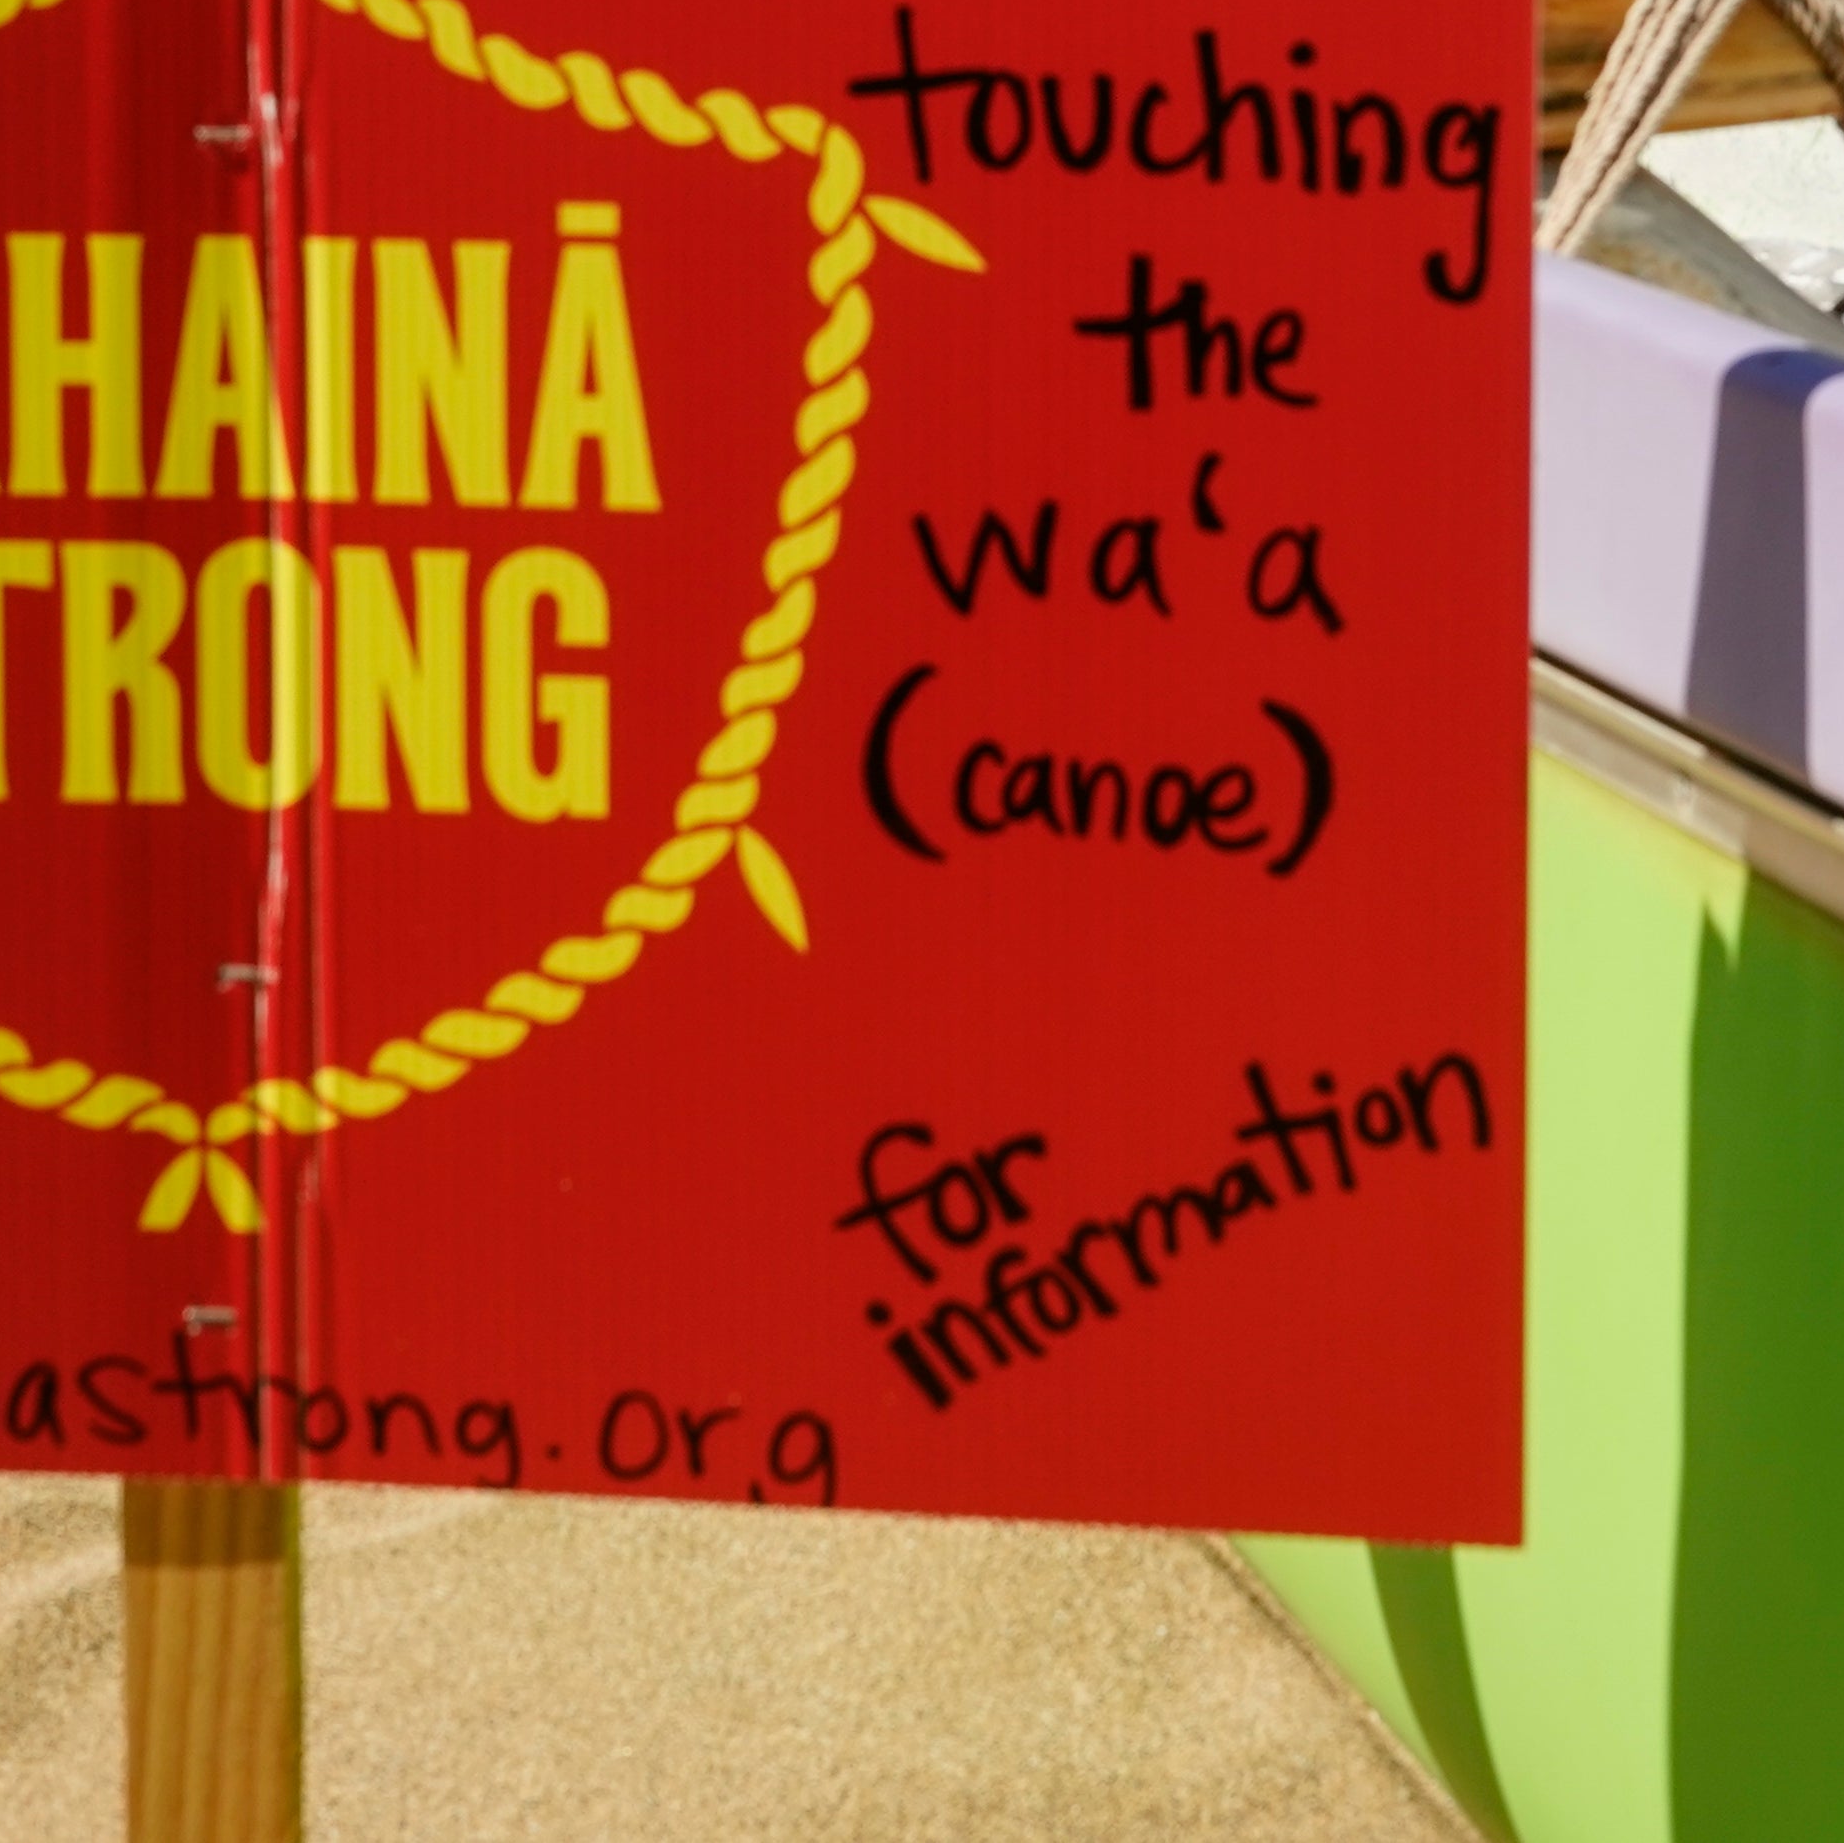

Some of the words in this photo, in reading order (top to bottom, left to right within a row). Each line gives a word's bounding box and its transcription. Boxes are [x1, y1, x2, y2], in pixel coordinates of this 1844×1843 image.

[847, 4, 1500, 305] touching
[1074, 254, 1320, 412] the
[862, 662, 1334, 878] (canoe)
[835, 1123, 1047, 1282] for
[867, 1050, 1493, 1410] information
